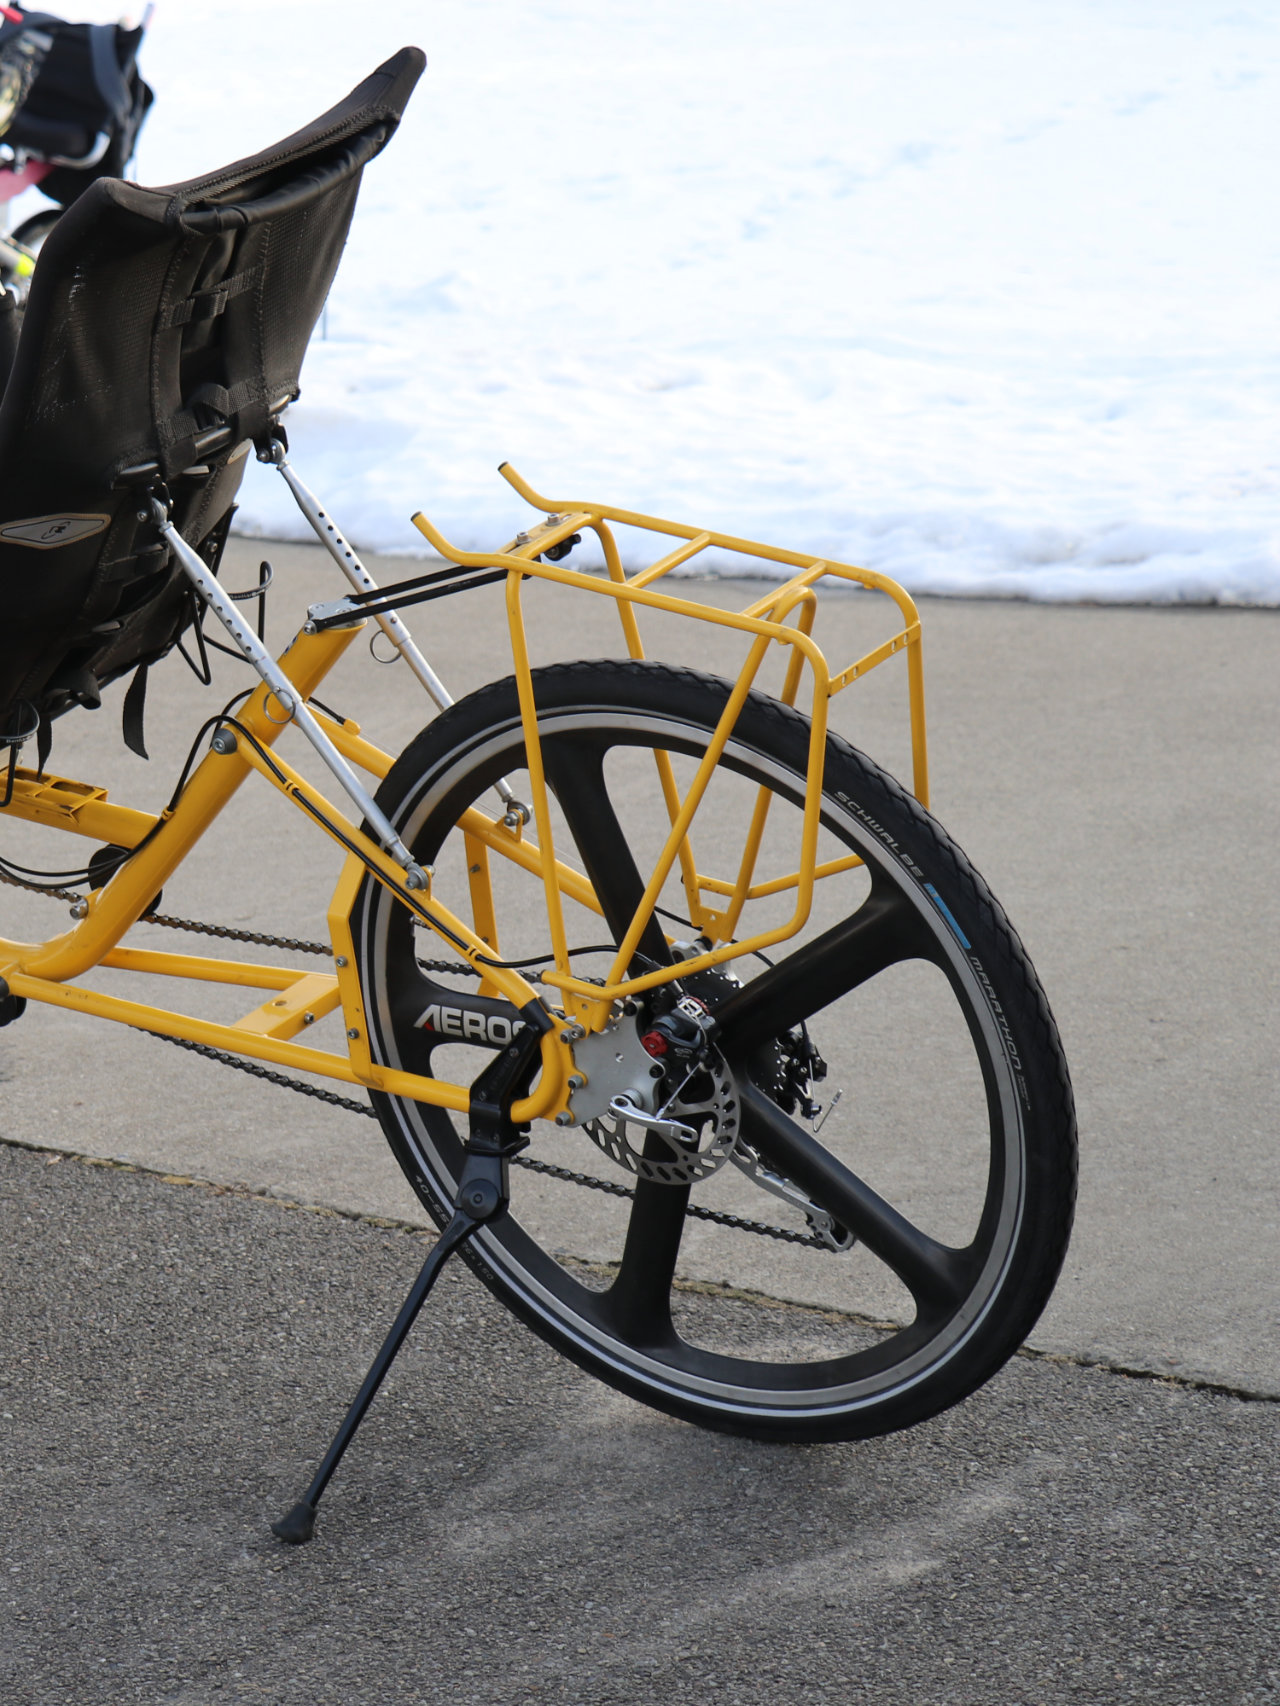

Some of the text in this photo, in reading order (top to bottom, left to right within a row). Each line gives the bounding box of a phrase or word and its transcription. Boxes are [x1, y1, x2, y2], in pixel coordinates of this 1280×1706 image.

[834, 791, 924, 877] SCHWALBE
[971, 956, 1022, 1071] MARATHON
[415, 1175, 451, 1227] 40-55
